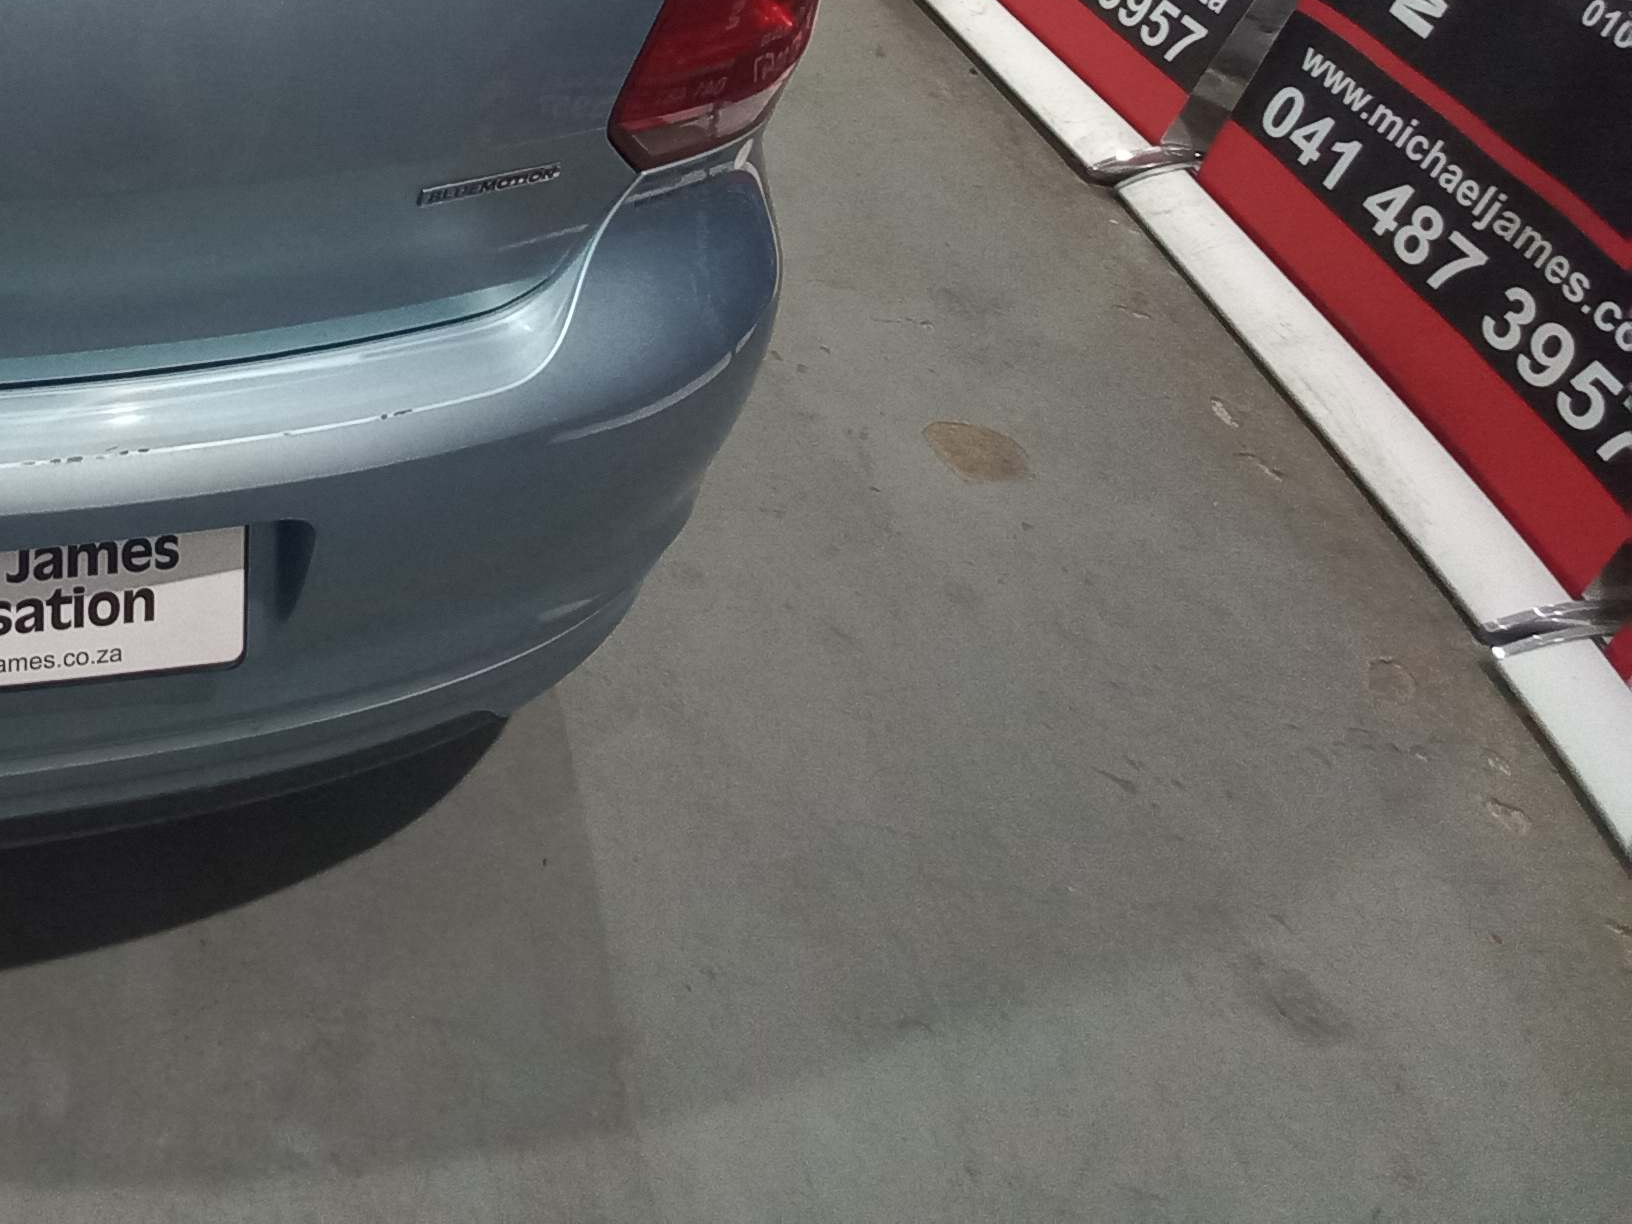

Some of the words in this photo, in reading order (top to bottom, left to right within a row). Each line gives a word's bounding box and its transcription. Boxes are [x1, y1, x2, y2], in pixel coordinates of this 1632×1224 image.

[1261, 86, 1363, 191] 041
[1362, 183, 1490, 291] 487
[6, 534, 180, 584] James
